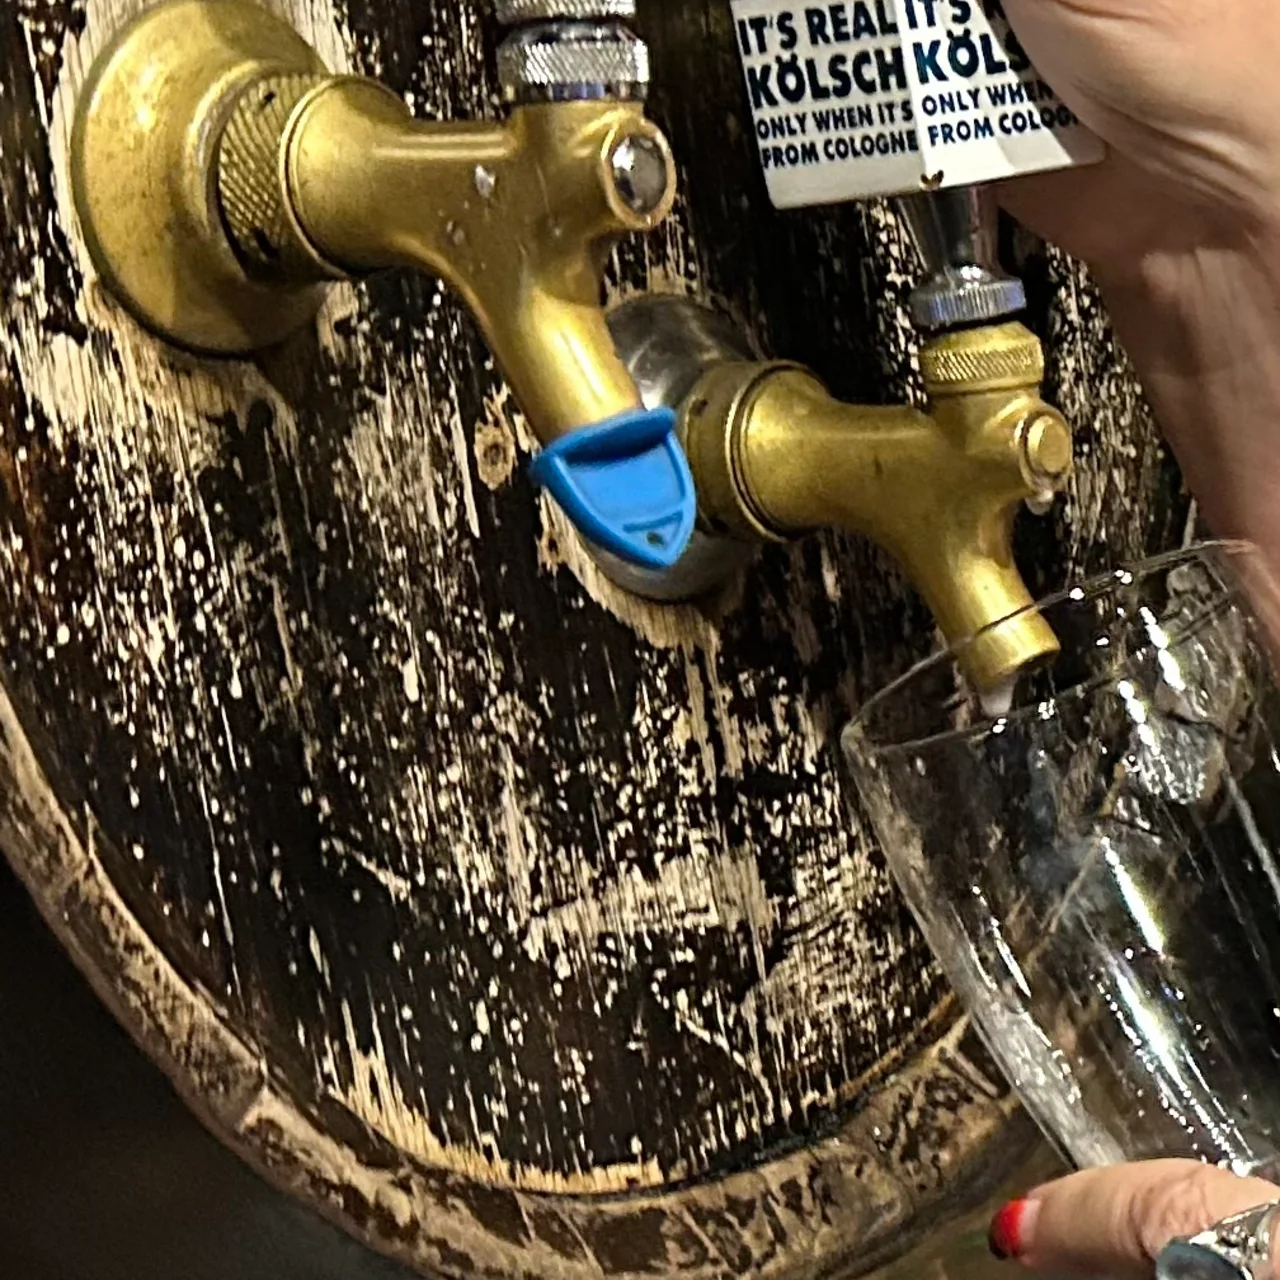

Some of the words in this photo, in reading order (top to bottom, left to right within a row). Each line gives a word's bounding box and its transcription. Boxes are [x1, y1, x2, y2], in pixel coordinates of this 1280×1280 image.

[738, 11, 798, 55] IT'S
[747, 46, 908, 109] KÖLSCH
[757, 112, 807, 140] ONLY
[812, 104, 873, 132] WHEN
[878, 99, 914, 125] IT'S
[922, 88, 980, 116] ONLY
[762, 141, 819, 169] FROM
[824, 129, 919, 161] COLOGNE
[928, 117, 994, 147] FROM
